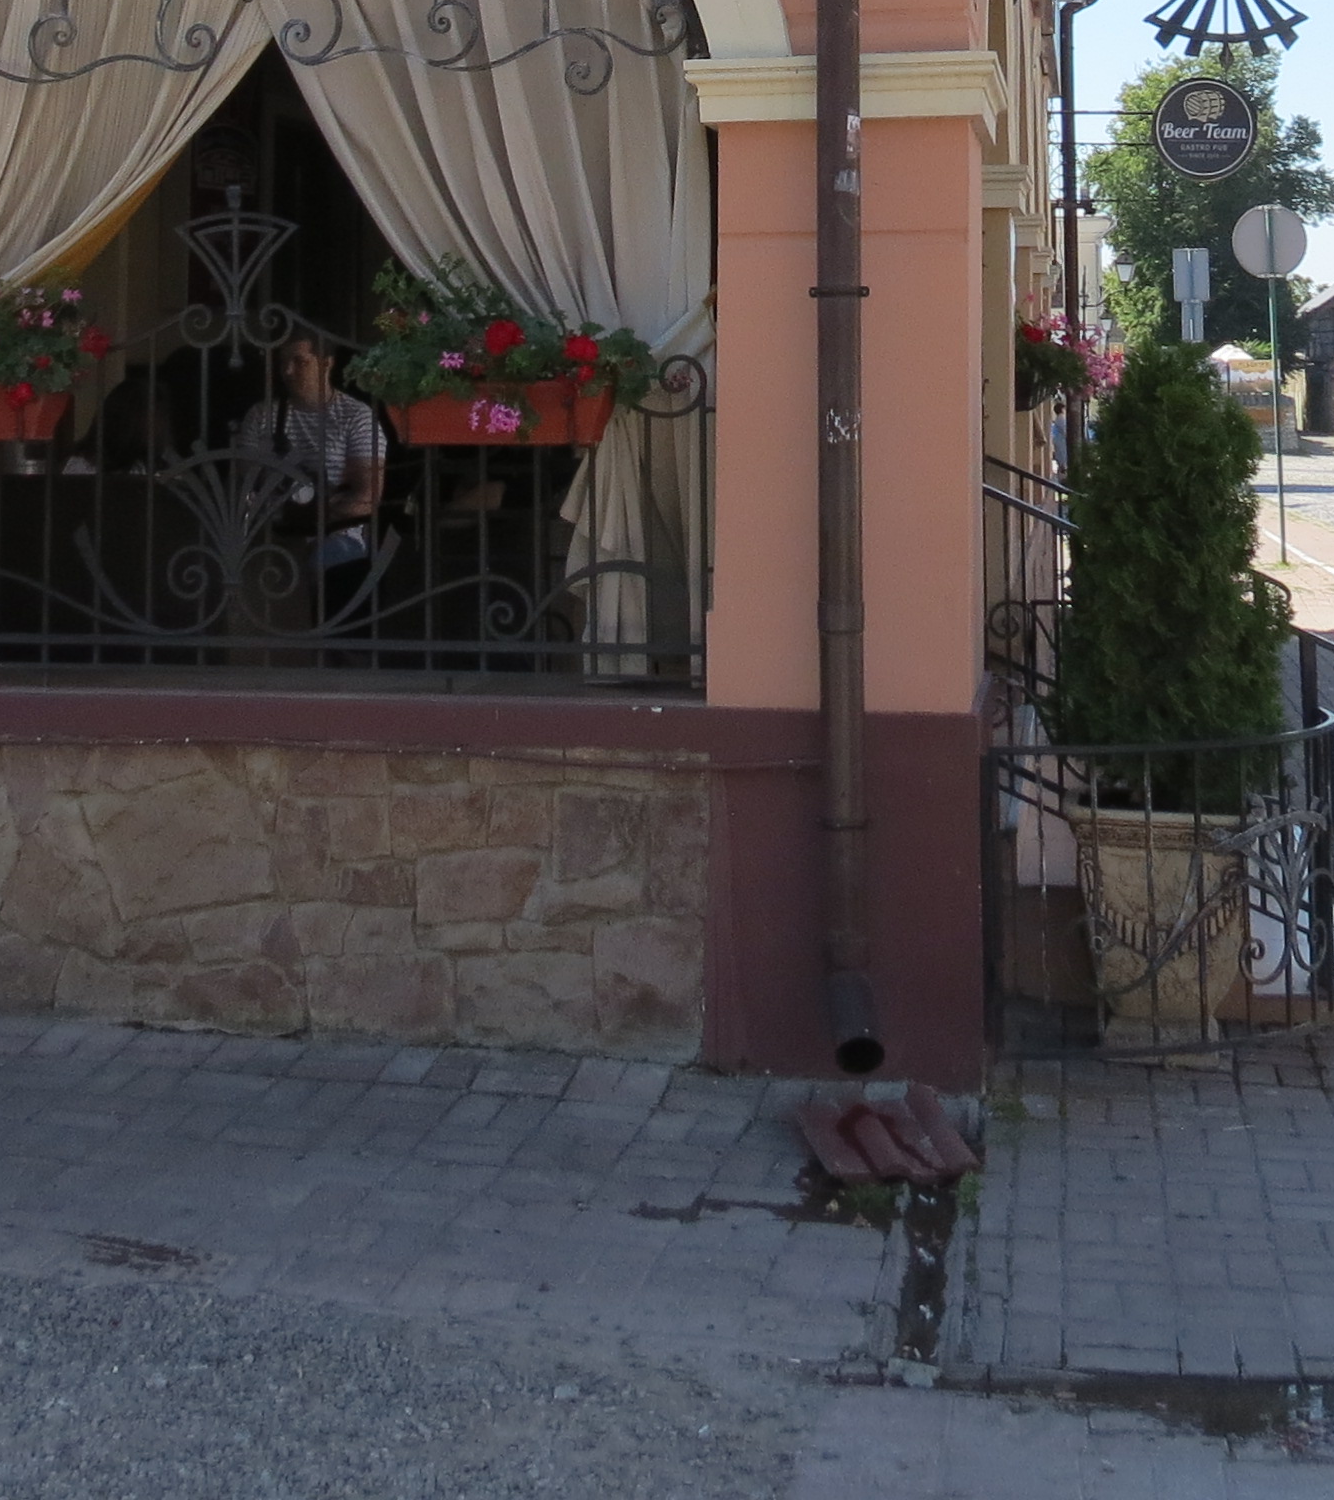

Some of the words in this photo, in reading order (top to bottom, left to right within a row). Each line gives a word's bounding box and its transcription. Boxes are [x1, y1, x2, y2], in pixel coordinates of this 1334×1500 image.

[1161, 122, 1199, 139] Beer
[1203, 122, 1248, 139] Team
[1180, 143, 1211, 151] GASTRO
